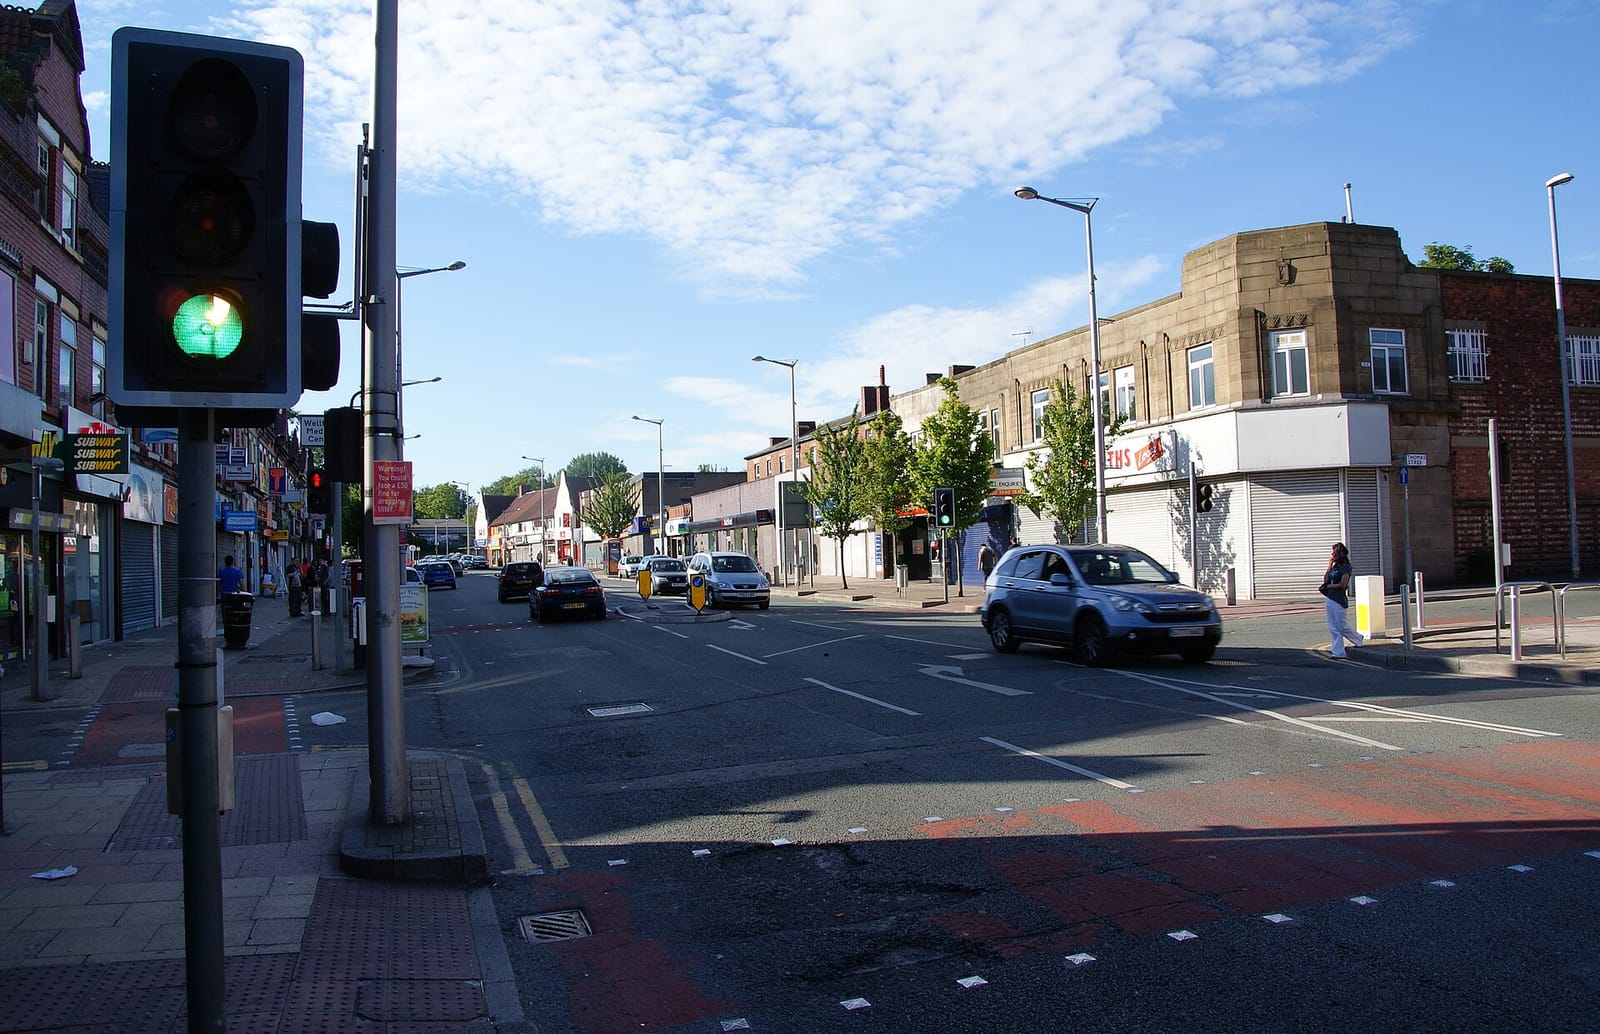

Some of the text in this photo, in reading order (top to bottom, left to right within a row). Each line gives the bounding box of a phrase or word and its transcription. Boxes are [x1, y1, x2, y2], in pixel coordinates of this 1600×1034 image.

[74, 437, 121, 447] SUBWAY
[74, 449, 121, 459] SUBWAY
[74, 461, 121, 471] SUBWAY
[377, 465, 406, 474] Warning!
